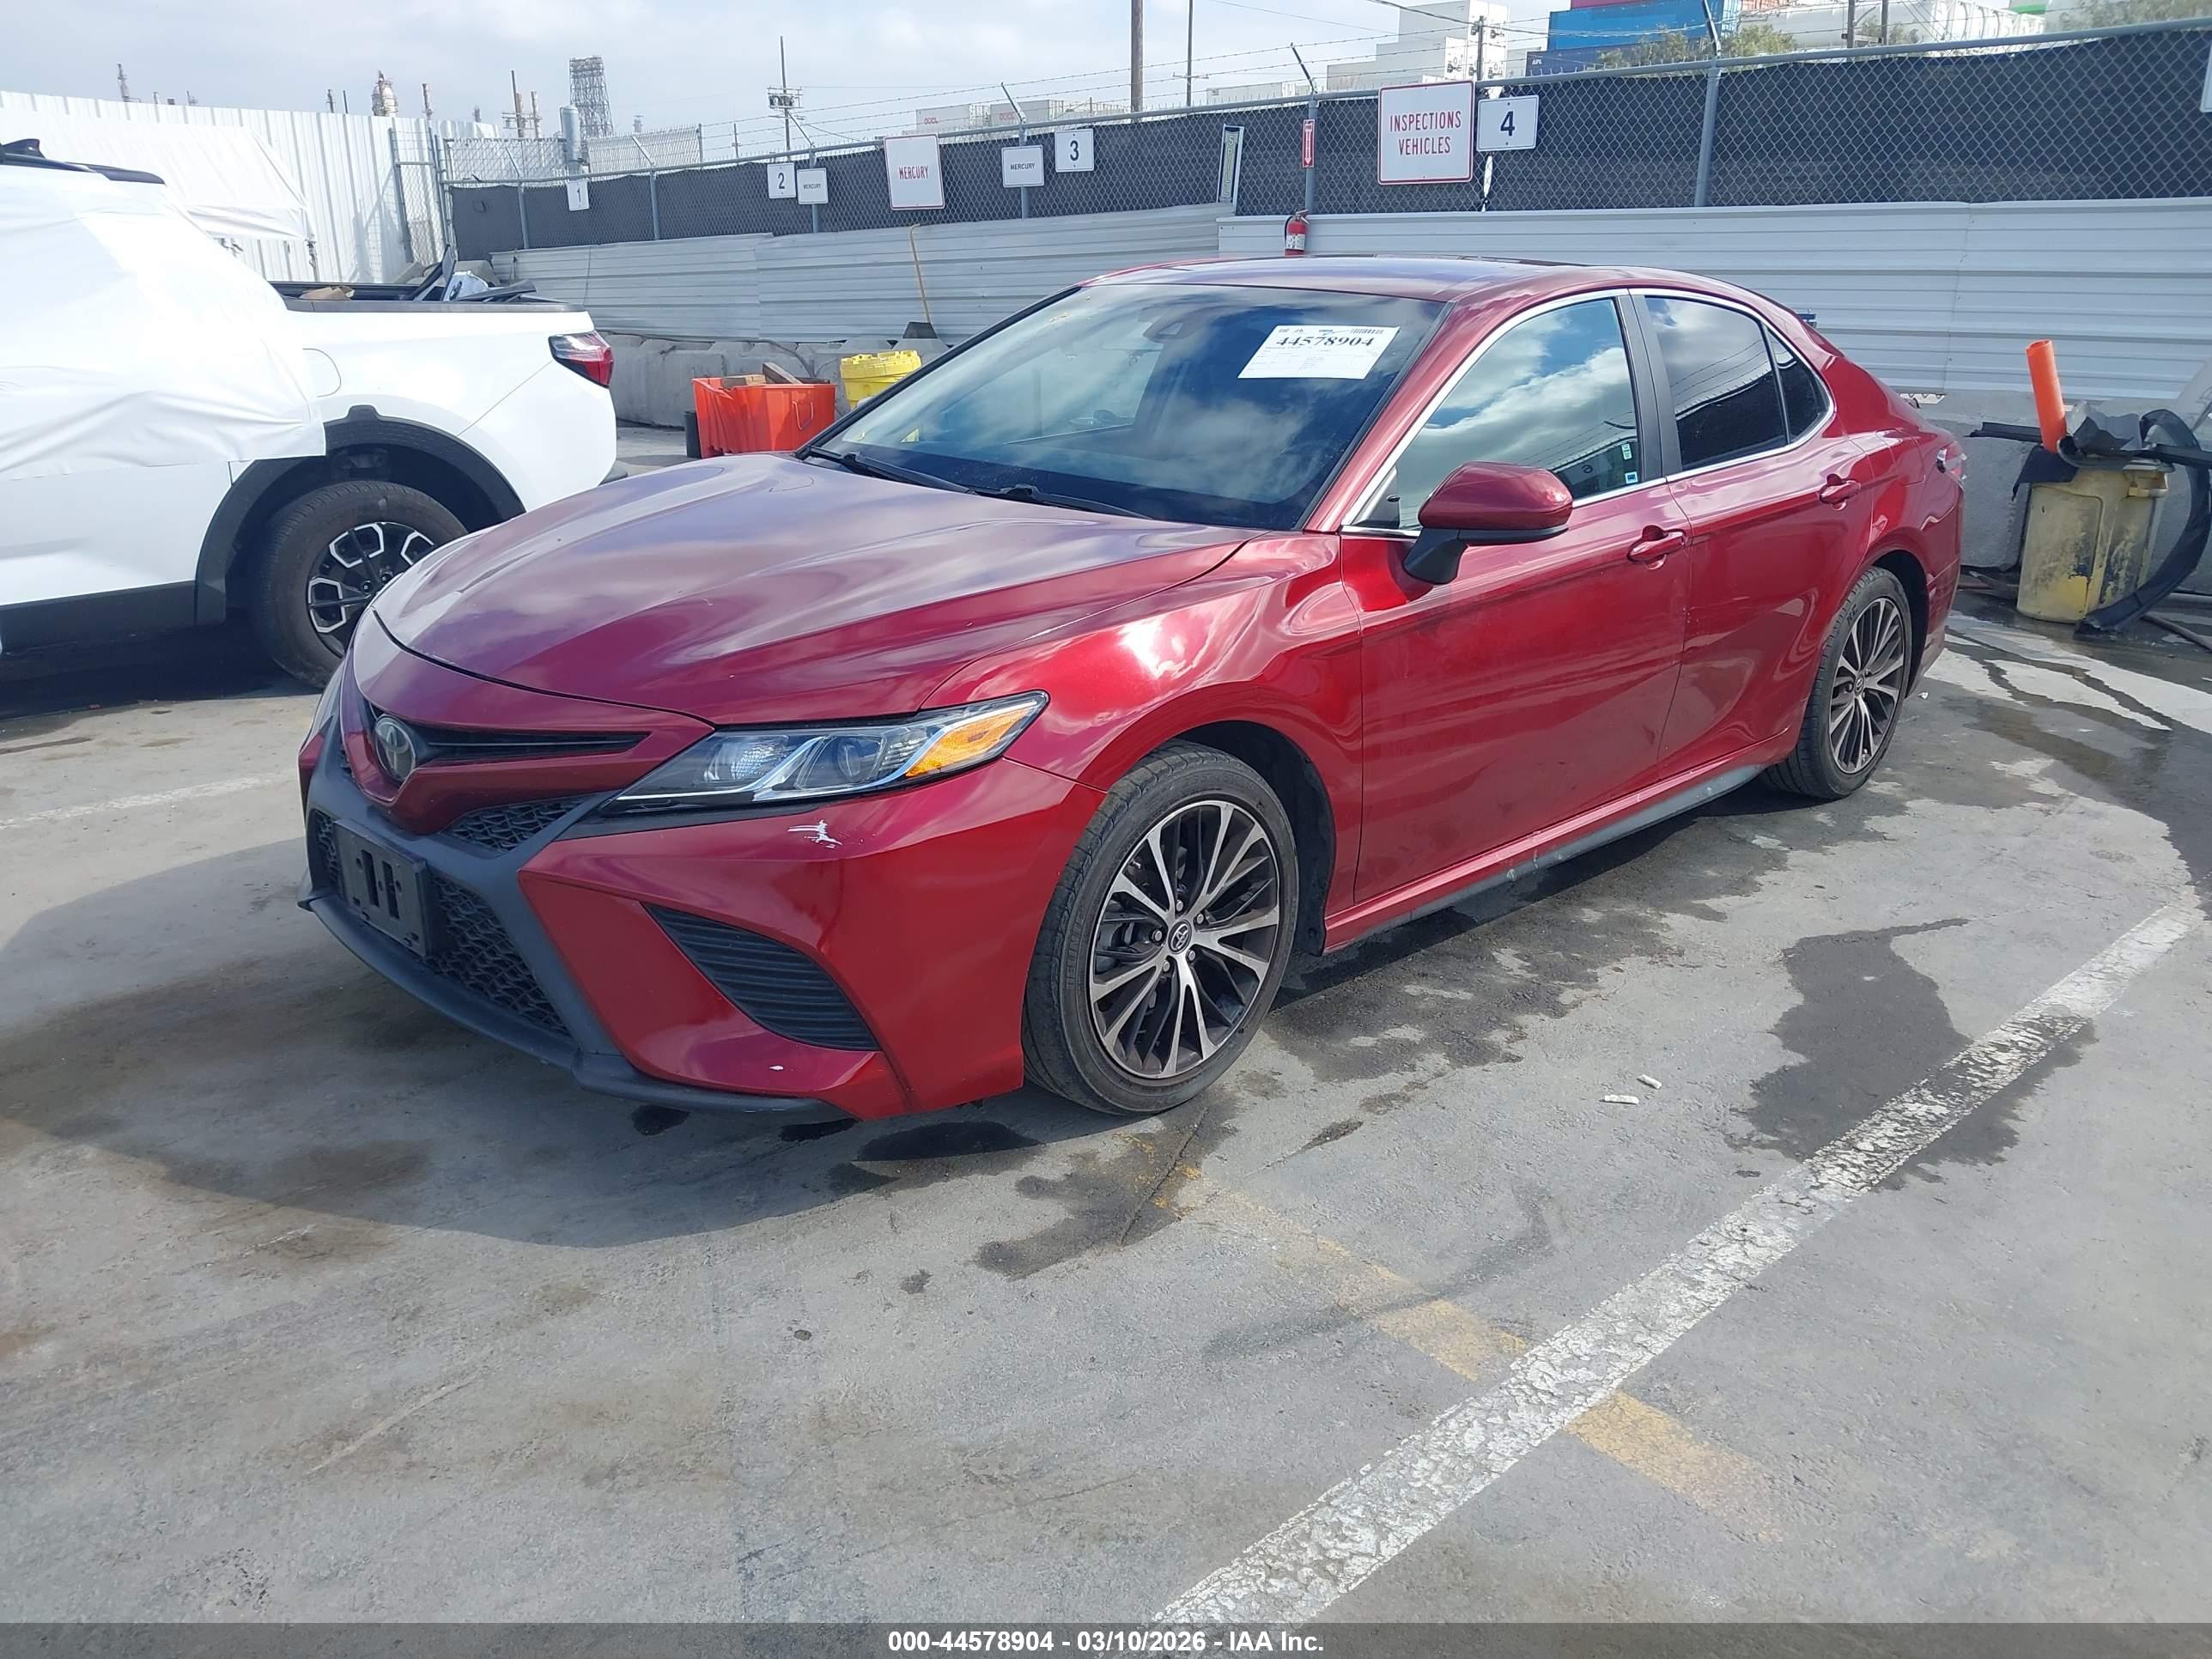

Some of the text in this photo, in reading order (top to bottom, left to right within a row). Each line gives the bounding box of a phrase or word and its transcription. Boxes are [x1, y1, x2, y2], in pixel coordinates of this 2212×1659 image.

[1389, 110, 1462, 132] INSPECTIONS
[1499, 111, 1516, 137] 4
[1069, 140, 1079, 161] 3
[1398, 136, 1451, 156] VEHICLES
[898, 165, 928, 179] MERCURY
[1224, 135, 1235, 196] SPILL
[777, 173, 785, 189] 2
[577, 185, 581, 203] 1
[1276, 336, 1375, 347] 44578904
